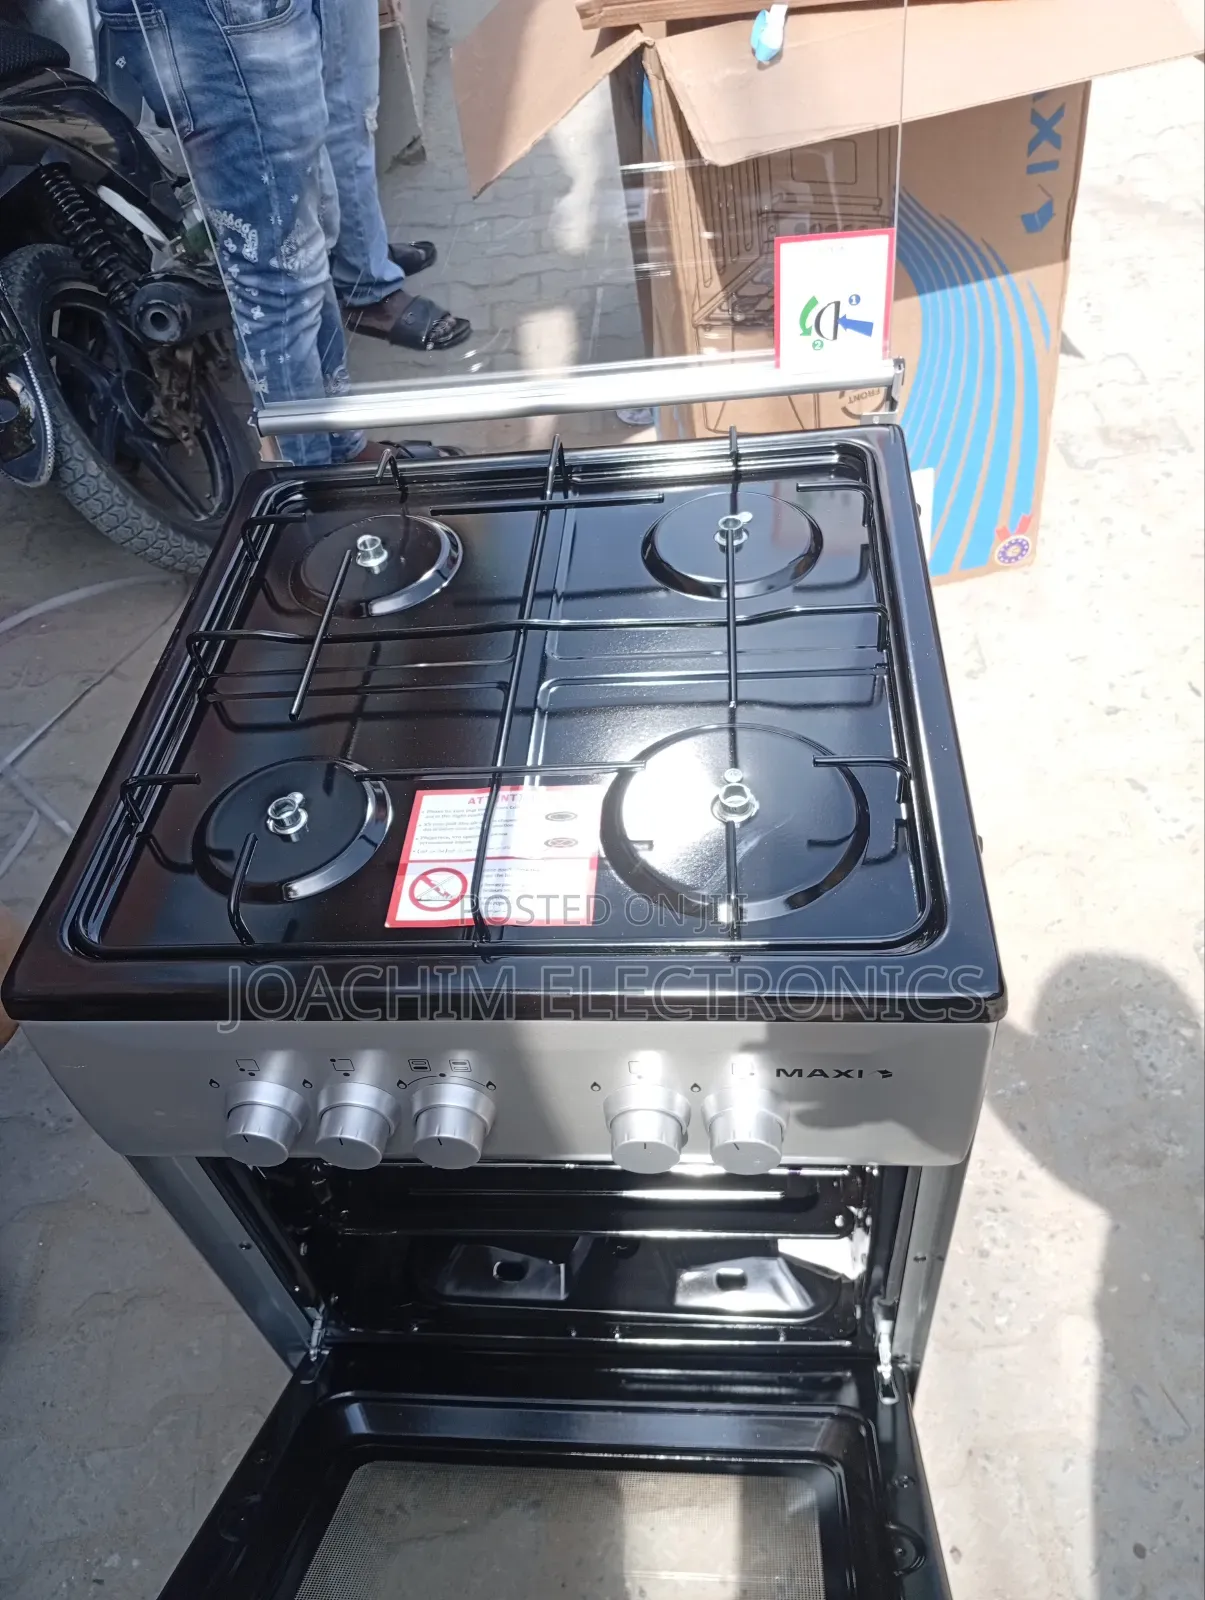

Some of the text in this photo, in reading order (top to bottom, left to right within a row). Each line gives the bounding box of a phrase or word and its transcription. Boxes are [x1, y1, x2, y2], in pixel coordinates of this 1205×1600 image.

[850, 295, 860, 305] 1
[812, 339, 824, 350] 2
[848, 387, 881, 404] FRONT
[776, 1068, 864, 1079] MAXI
